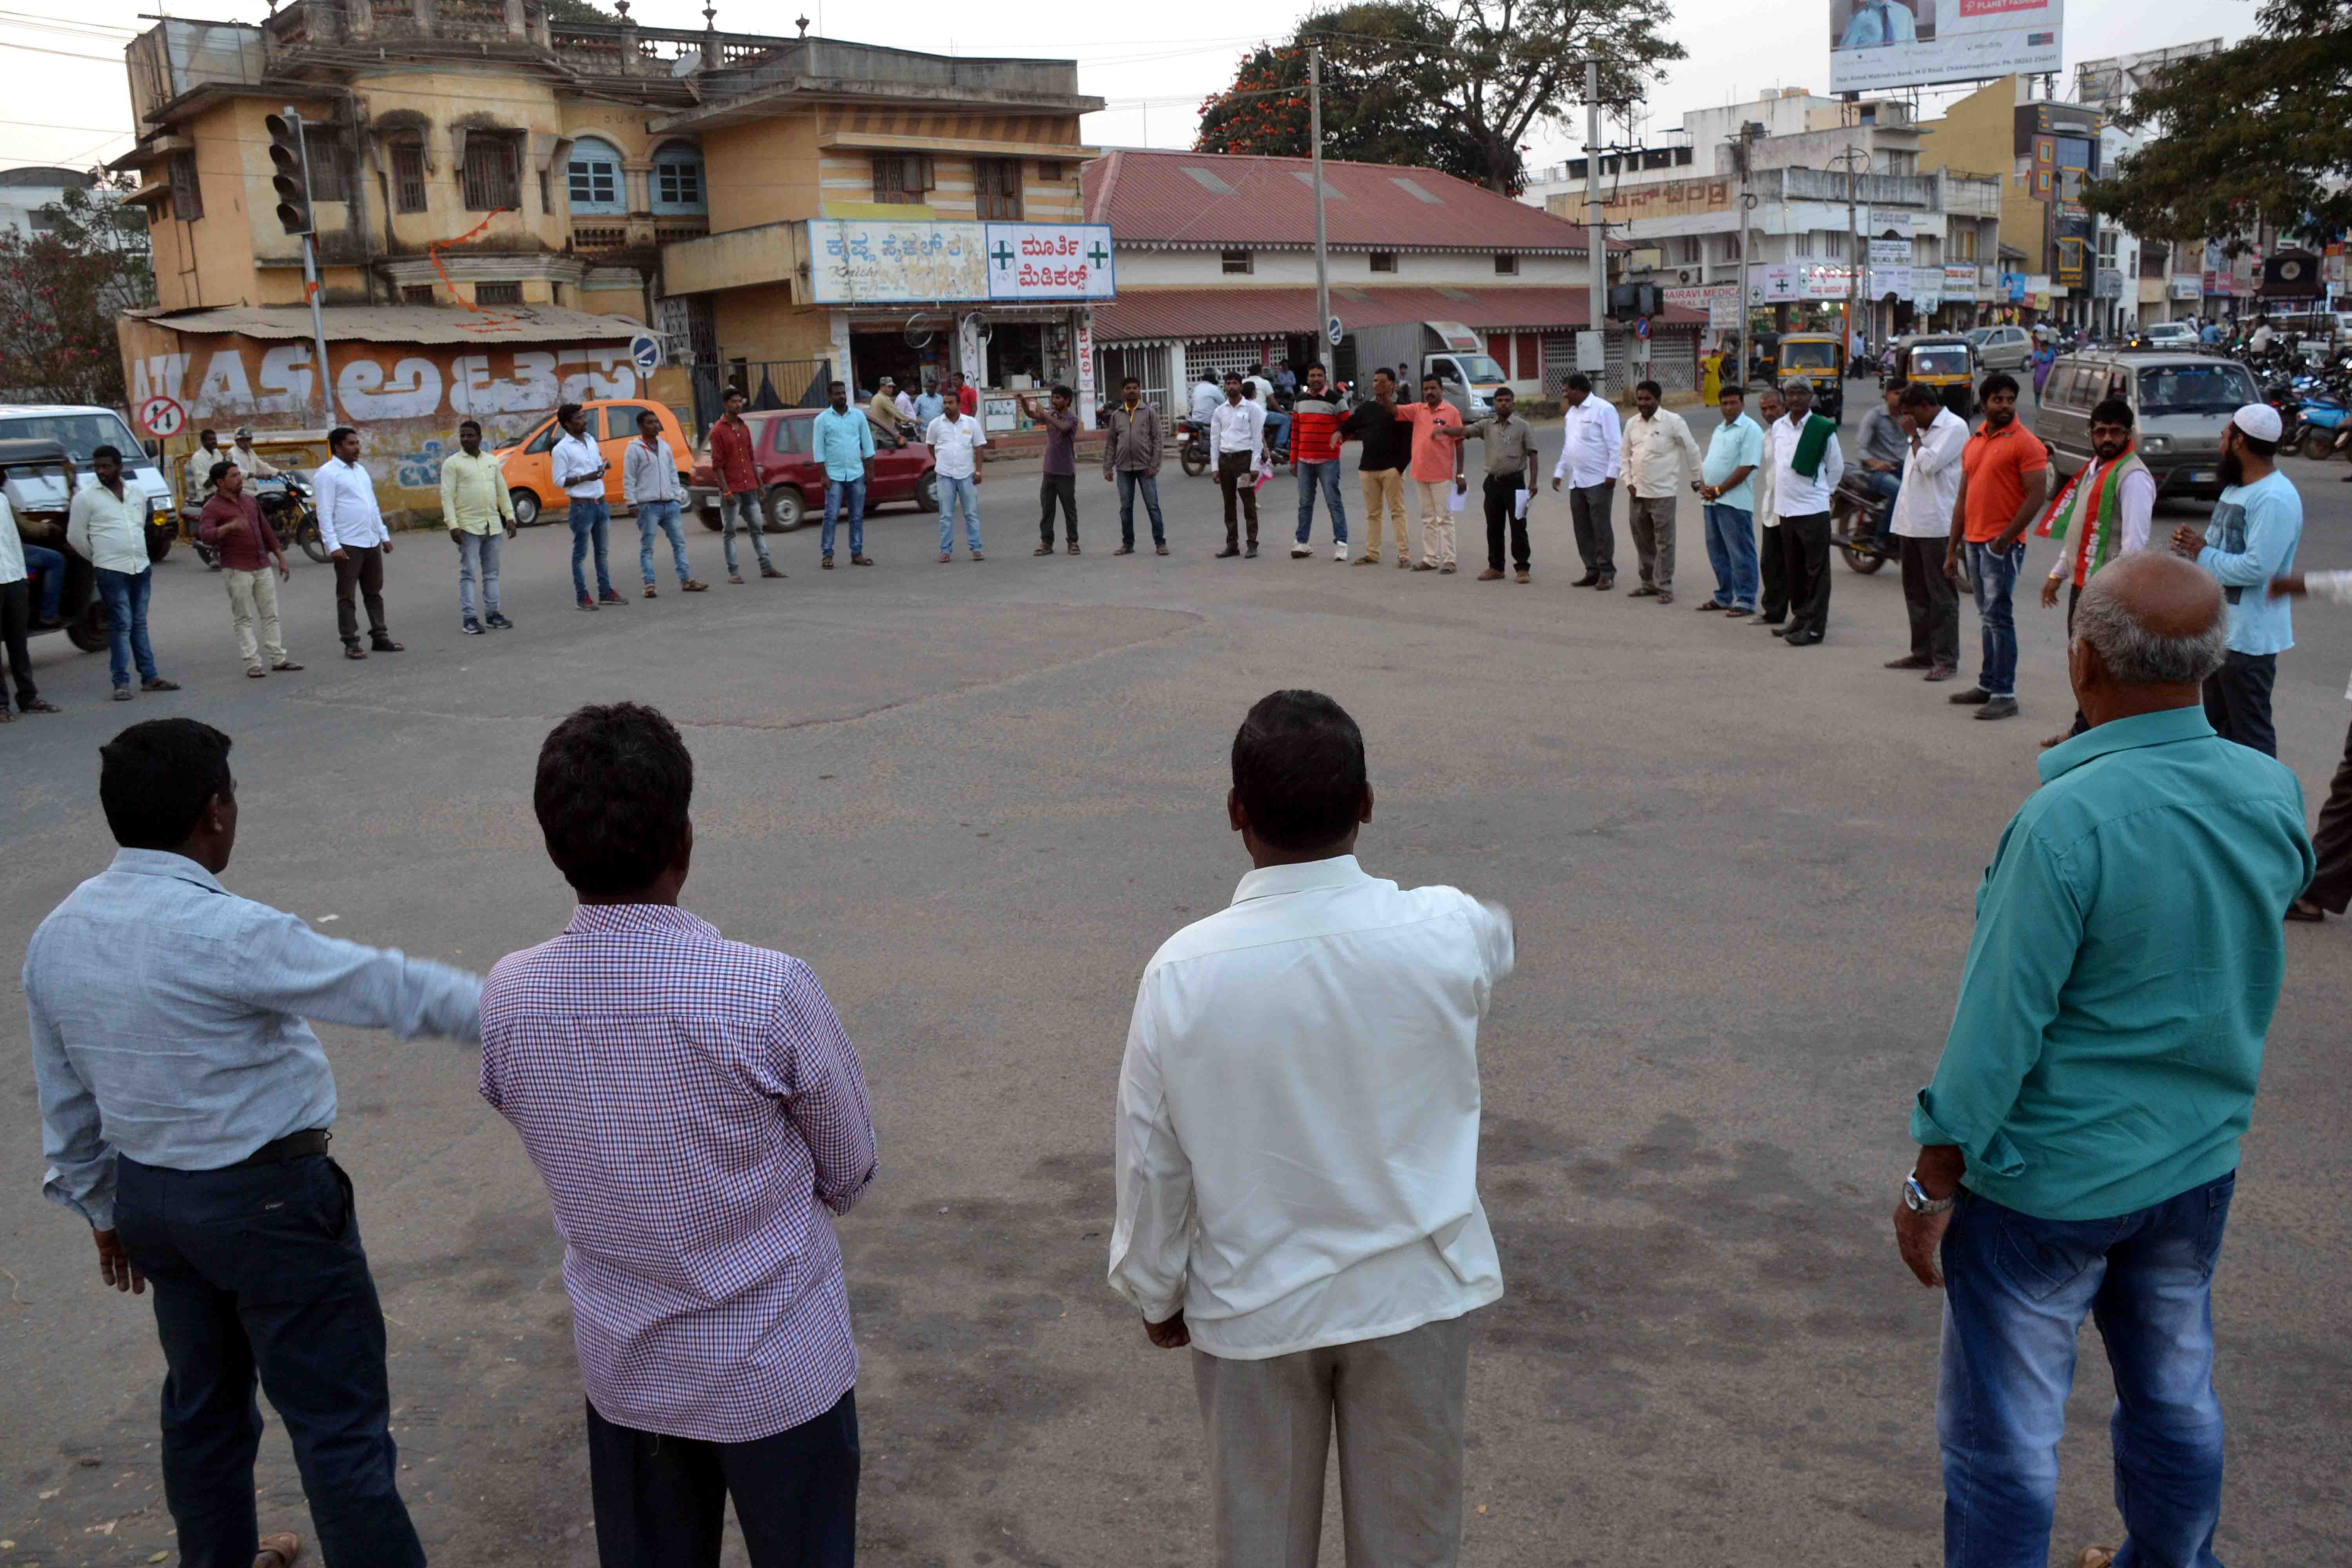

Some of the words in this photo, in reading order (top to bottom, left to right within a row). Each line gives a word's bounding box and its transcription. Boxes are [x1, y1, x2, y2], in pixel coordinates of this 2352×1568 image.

[1022, 234, 1078, 256] ಮೂರ್ತಿ
[1019, 263, 1087, 290] ಮೆಡಿಕಲ್ಸ್
[1704, 288, 1741, 297] MEDICA
